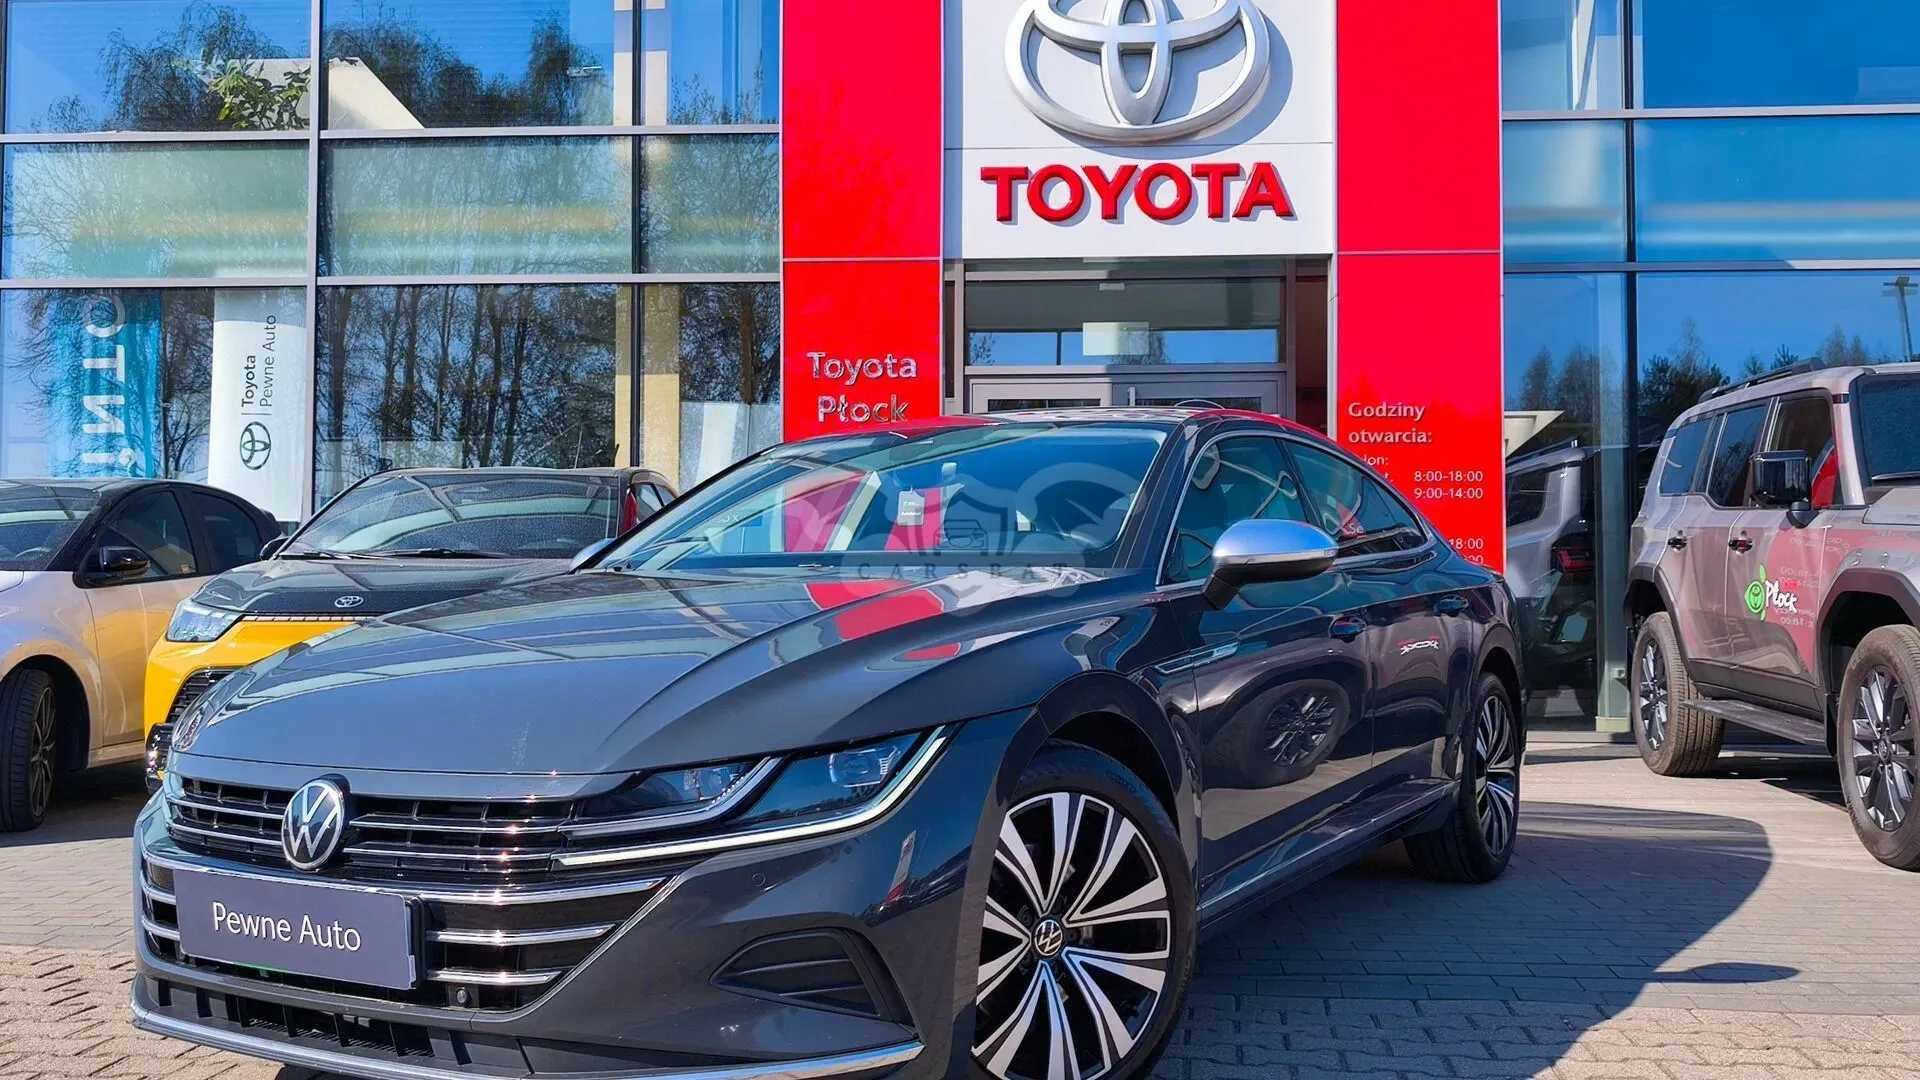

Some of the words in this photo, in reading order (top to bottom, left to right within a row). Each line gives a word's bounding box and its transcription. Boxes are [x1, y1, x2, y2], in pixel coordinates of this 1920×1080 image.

[980, 162, 1295, 222] TOYOTA
[263, 314, 277, 352] Auto
[241, 355, 257, 407] Toyota
[260, 356, 274, 407] Pewne
[807, 352, 917, 385] Toyota
[1348, 402, 1425, 421] Godziny
[1348, 428, 1432, 443] otwarcia:
[1414, 471, 1483, 482] 8:00-18:00
[1414, 488, 1483, 499] 9:00-14:00
[213, 902, 292, 942] Pewne
[300, 915, 361, 951] Auto
